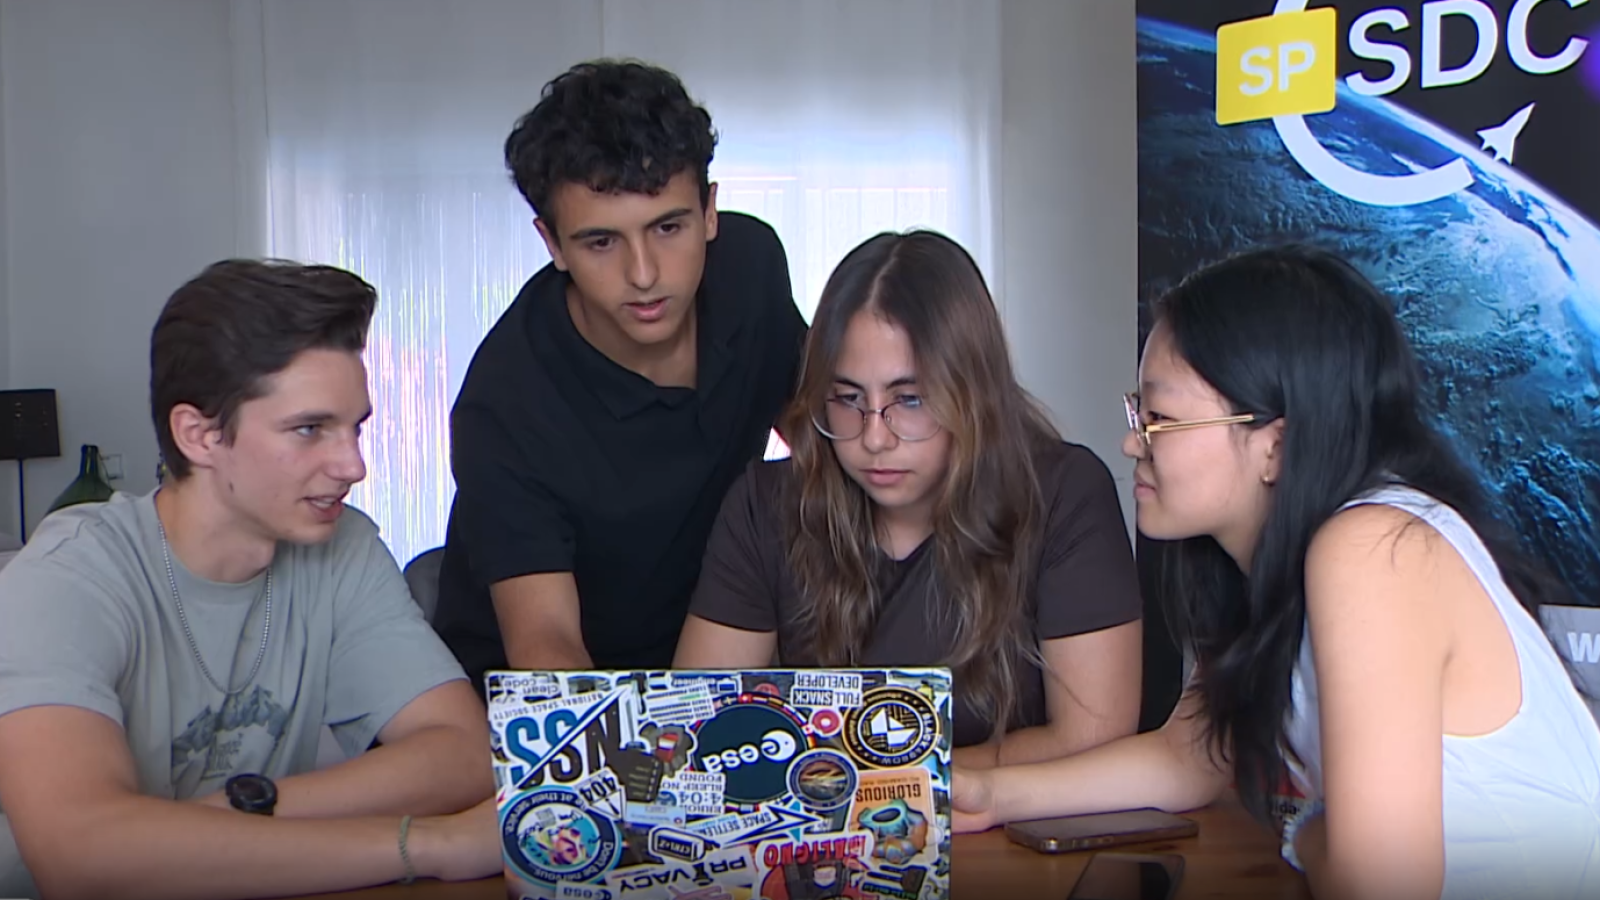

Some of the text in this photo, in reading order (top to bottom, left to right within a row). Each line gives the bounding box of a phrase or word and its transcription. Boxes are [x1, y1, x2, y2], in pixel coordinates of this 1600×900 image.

[1239, 0, 1589, 97] SP SDC
[503, 679, 537, 690] code
[796, 675, 859, 689] DEVELOPER
[522, 685, 559, 697] clean
[794, 691, 833, 705] SNACK
[835, 691, 860, 705] FULL
[493, 706, 529, 720] SOCIETY
[531, 700, 559, 712] SPACE
[505, 701, 620, 790] NSS
[678, 774, 723, 783] FOUND
[579, 777, 616, 804] 404
[661, 782, 680, 790] NO
[678, 792, 722, 805] 4:04
[855, 784, 921, 803] GLORIOUS
[679, 805, 722, 814] ERRO
[741, 812, 771, 829] SPACE
